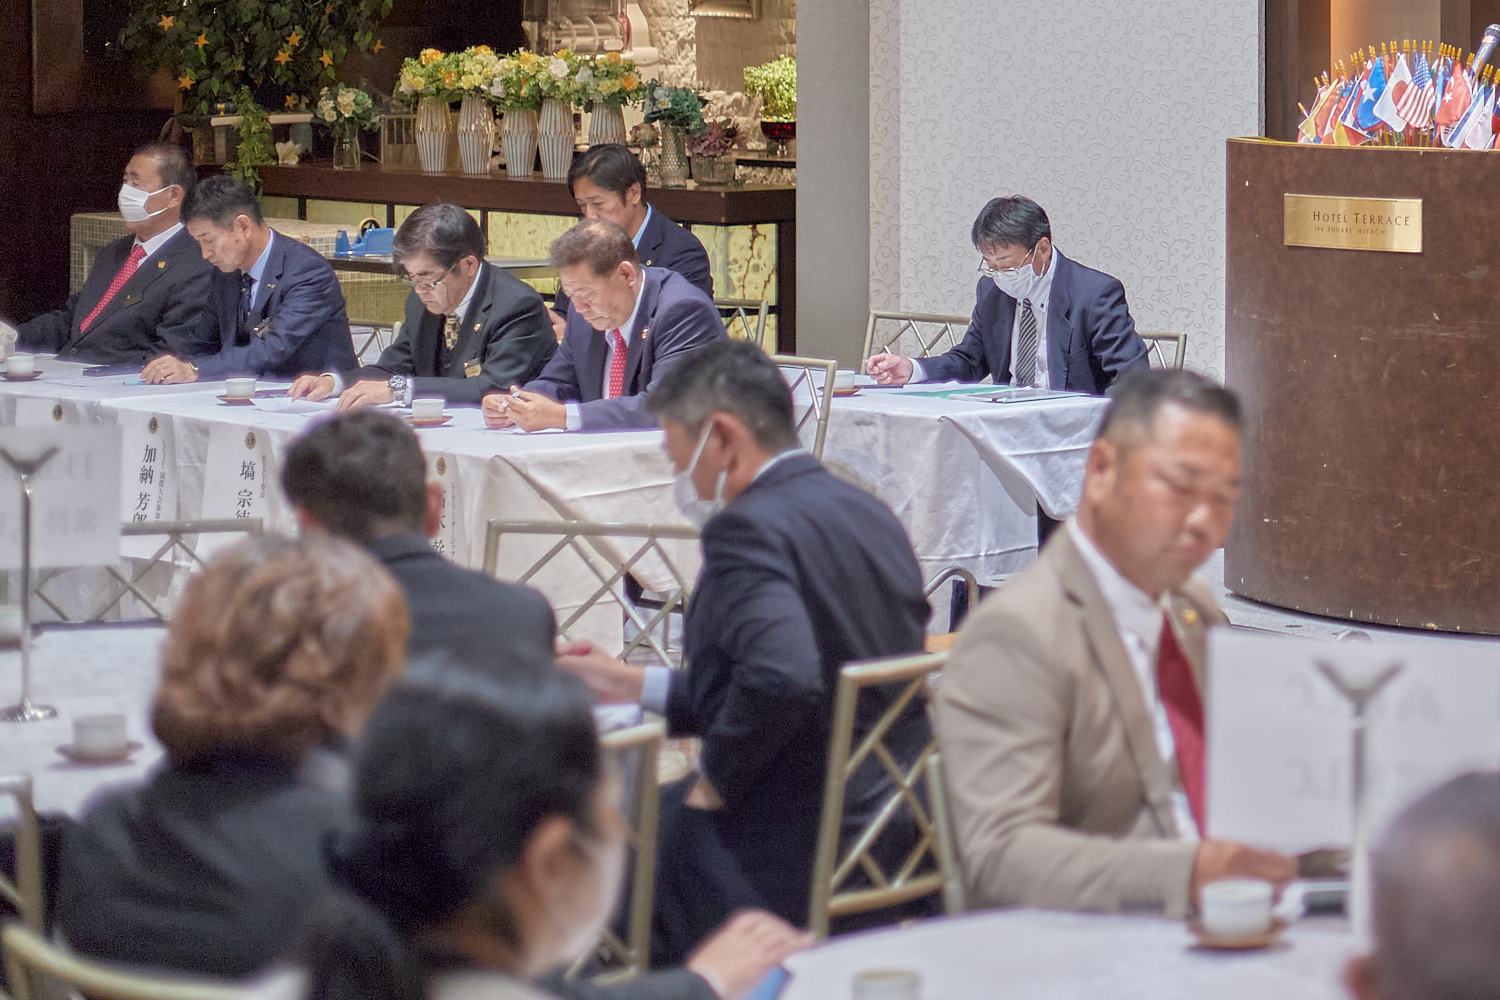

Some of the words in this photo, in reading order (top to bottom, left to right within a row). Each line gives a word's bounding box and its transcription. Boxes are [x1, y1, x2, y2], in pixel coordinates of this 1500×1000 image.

[1312, 210, 1348, 223] HOTEL
[1353, 212, 1410, 226] TERRACE
[1357, 228, 1388, 236] HITACHI
[138, 444, 157, 485] 加納
[240, 460, 256, 480] 塙
